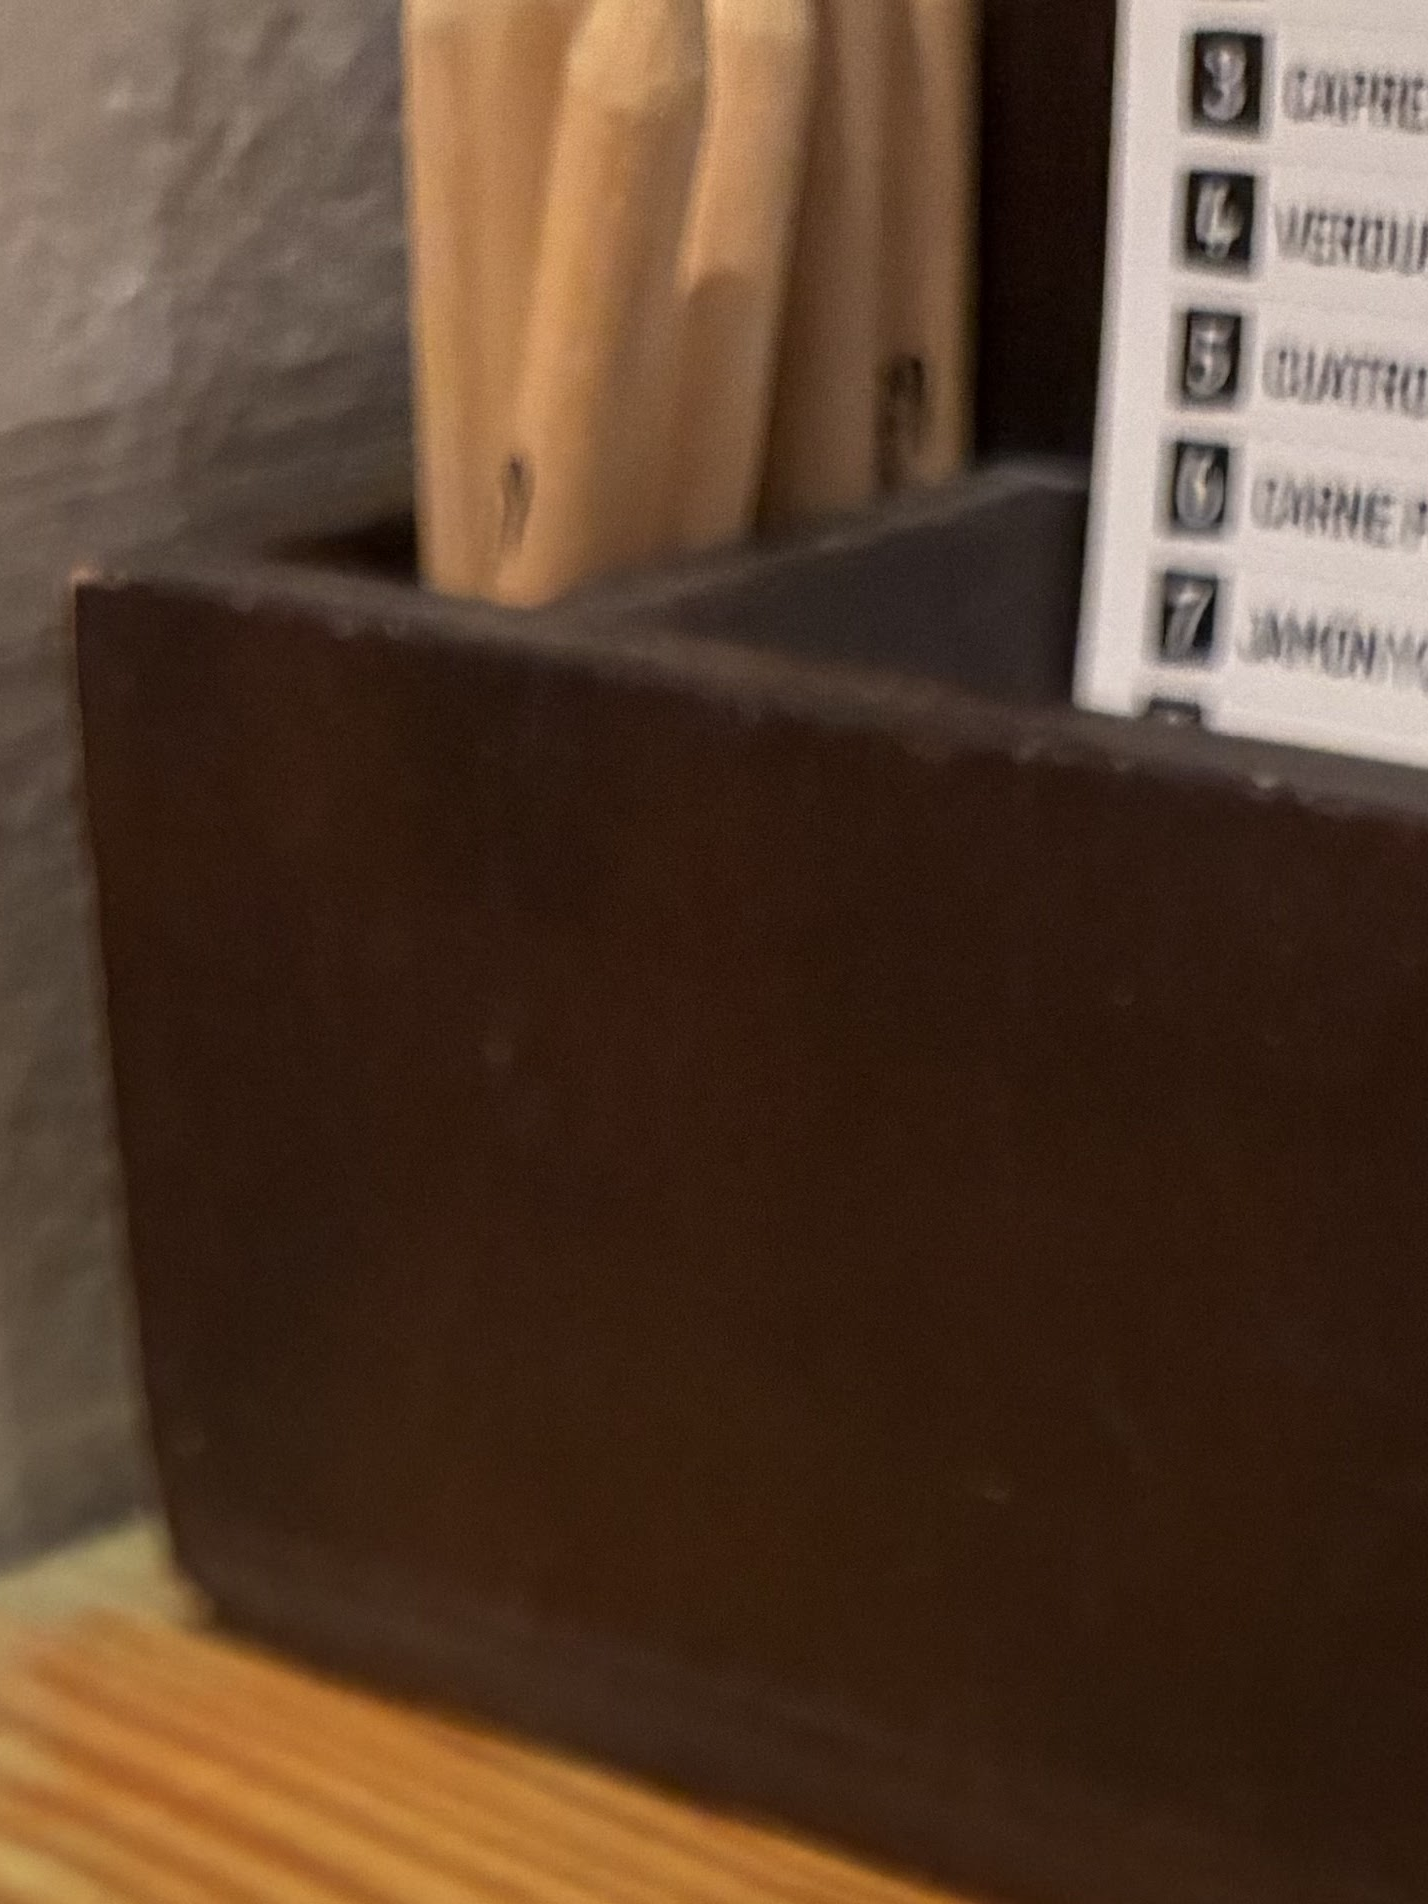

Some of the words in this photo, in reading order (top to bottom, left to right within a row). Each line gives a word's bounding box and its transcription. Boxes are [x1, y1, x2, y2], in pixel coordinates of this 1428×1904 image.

[1202, 35, 1250, 122] 3
[1193, 177, 1245, 260] 4
[1185, 313, 1233, 398] 5
[1250, 474, 1394, 549] CARNE
[1162, 583, 1213, 663] 7
